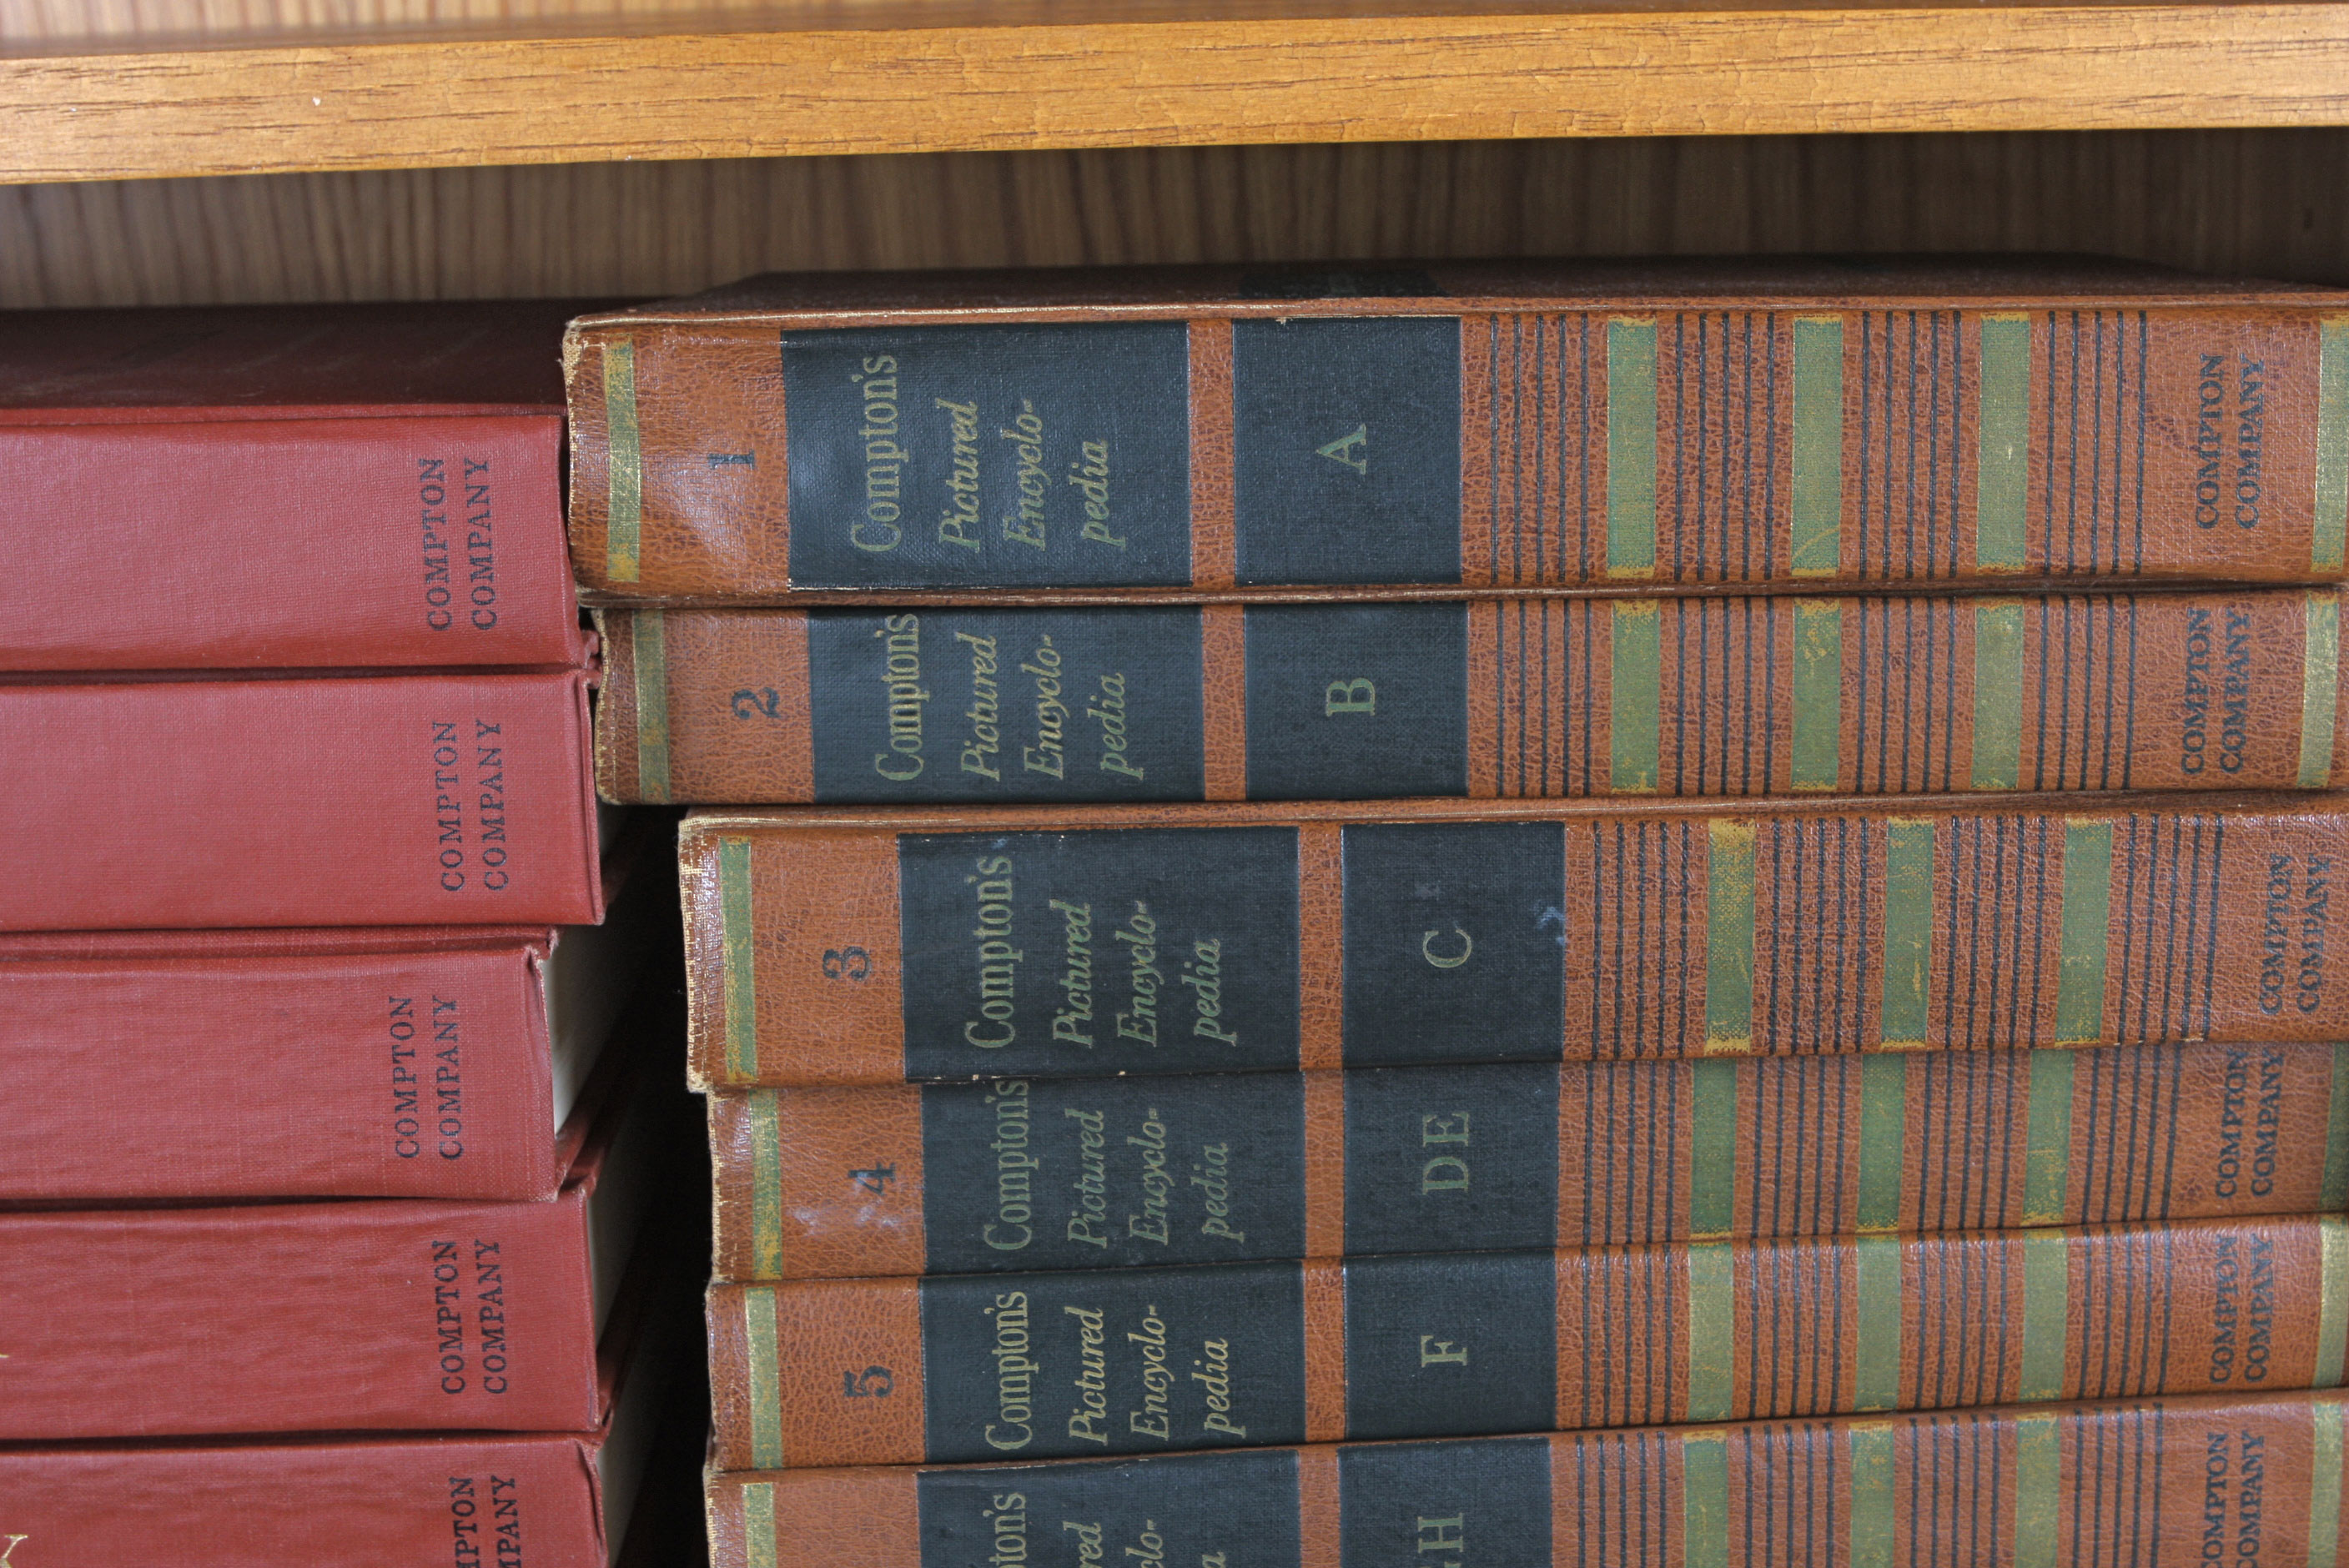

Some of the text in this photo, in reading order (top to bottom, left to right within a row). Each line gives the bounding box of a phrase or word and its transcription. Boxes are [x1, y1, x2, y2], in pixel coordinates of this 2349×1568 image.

[707, 450, 755, 470] 1
[851, 355, 908, 551] Compton's
[936, 398, 979, 552] Pictured
[1000, 400, 1051, 550] Encyclo-
[1068, 440, 1125, 550] pedia
[1315, 424, 1367, 475] A
[2196, 354, 2226, 530] COMPTON
[2236, 354, 2264, 530] COMPANY
[419, 459, 452, 631] COMPTON
[464, 458, 497, 631] COMPANY
[732, 687, 778, 719] 2
[874, 614, 932, 781] Compton's
[956, 632, 1001, 781] Pictured
[1020, 635, 1069, 779] Encyclo-
[1086, 672, 1144, 780] pedia
[1325, 678, 1376, 716] B
[2181, 608, 2212, 775] COMPTON
[2221, 608, 2252, 773] COMPANY
[432, 721, 465, 892] COMPTON
[475, 719, 509, 891] COMPANY
[822, 947, 872, 982] 3
[964, 856, 1022, 1048] Compton's
[1049, 899, 1093, 1048] Pictured
[1114, 900, 1164, 1047] Encyclo-
[1183, 938, 1237, 1047] pedia
[1422, 928, 1472, 967] C
[2259, 852, 2292, 1015] COMPTON
[2296, 852, 2329, 1013] COMPANY
[389, 997, 420, 1158] COMPTON
[432, 995, 464, 1161] COMPANY
[2216, 1048, 2249, 1199] COMPTON
[2251, 1048, 2284, 1197] COMPANY
[848, 1163, 896, 1196] 4
[983, 1082, 1039, 1250] Compton's
[1064, 1108, 1107, 1249] Pictured
[1127, 1108, 1173, 1245] Encyclo-
[1190, 1142, 1245, 1243] pedia
[432, 1240, 466, 1395] COMPTON
[475, 1239, 508, 1394] COMPANY
[844, 1366, 893, 1400] 5
[984, 1291, 1039, 1450] Compton's
[1064, 1306, 1107, 1444] Pictured
[1127, 1305, 1174, 1440] Encyclo-
[1421, 1335, 1467, 1367] F
[2209, 1234, 2239, 1385] COMPTON
[2244, 1234, 2273, 1383] COMPANY
[1191, 1338, 1245, 1437] pedia
[449, 1477, 480, 1568] PTON
[490, 1475, 521, 1568] PANY
[983, 1492, 1027, 1568] ton's
[1417, 1512, 1464, 1568] H
